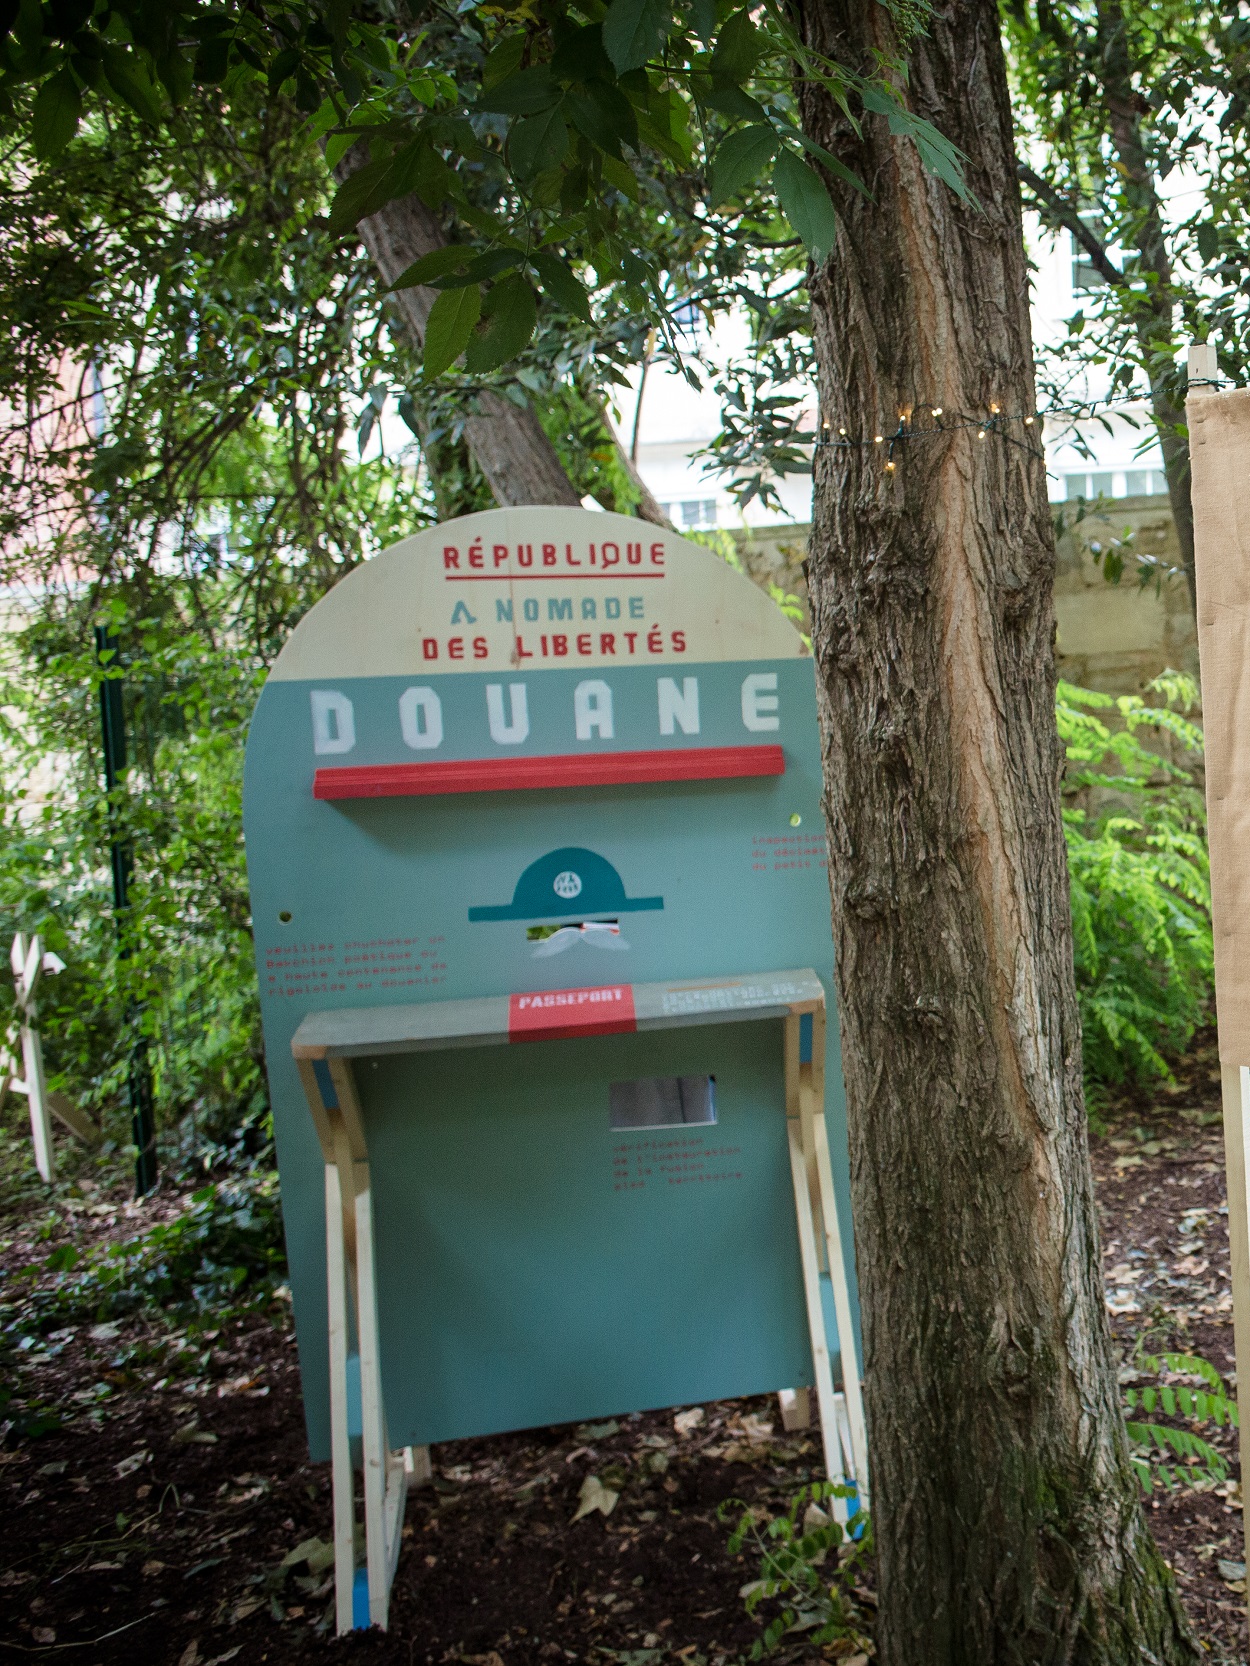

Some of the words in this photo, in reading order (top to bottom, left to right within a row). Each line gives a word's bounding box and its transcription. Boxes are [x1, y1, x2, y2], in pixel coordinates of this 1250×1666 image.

[442, 536, 666, 569] RÉPUBLIQUE
[496, 596, 645, 622] NOMADE
[422, 636, 489, 661] DES
[516, 623, 687, 659] LIBERTÉS
[310, 672, 781, 756] DOUANE
[518, 988, 623, 1010] PASSEPORT
